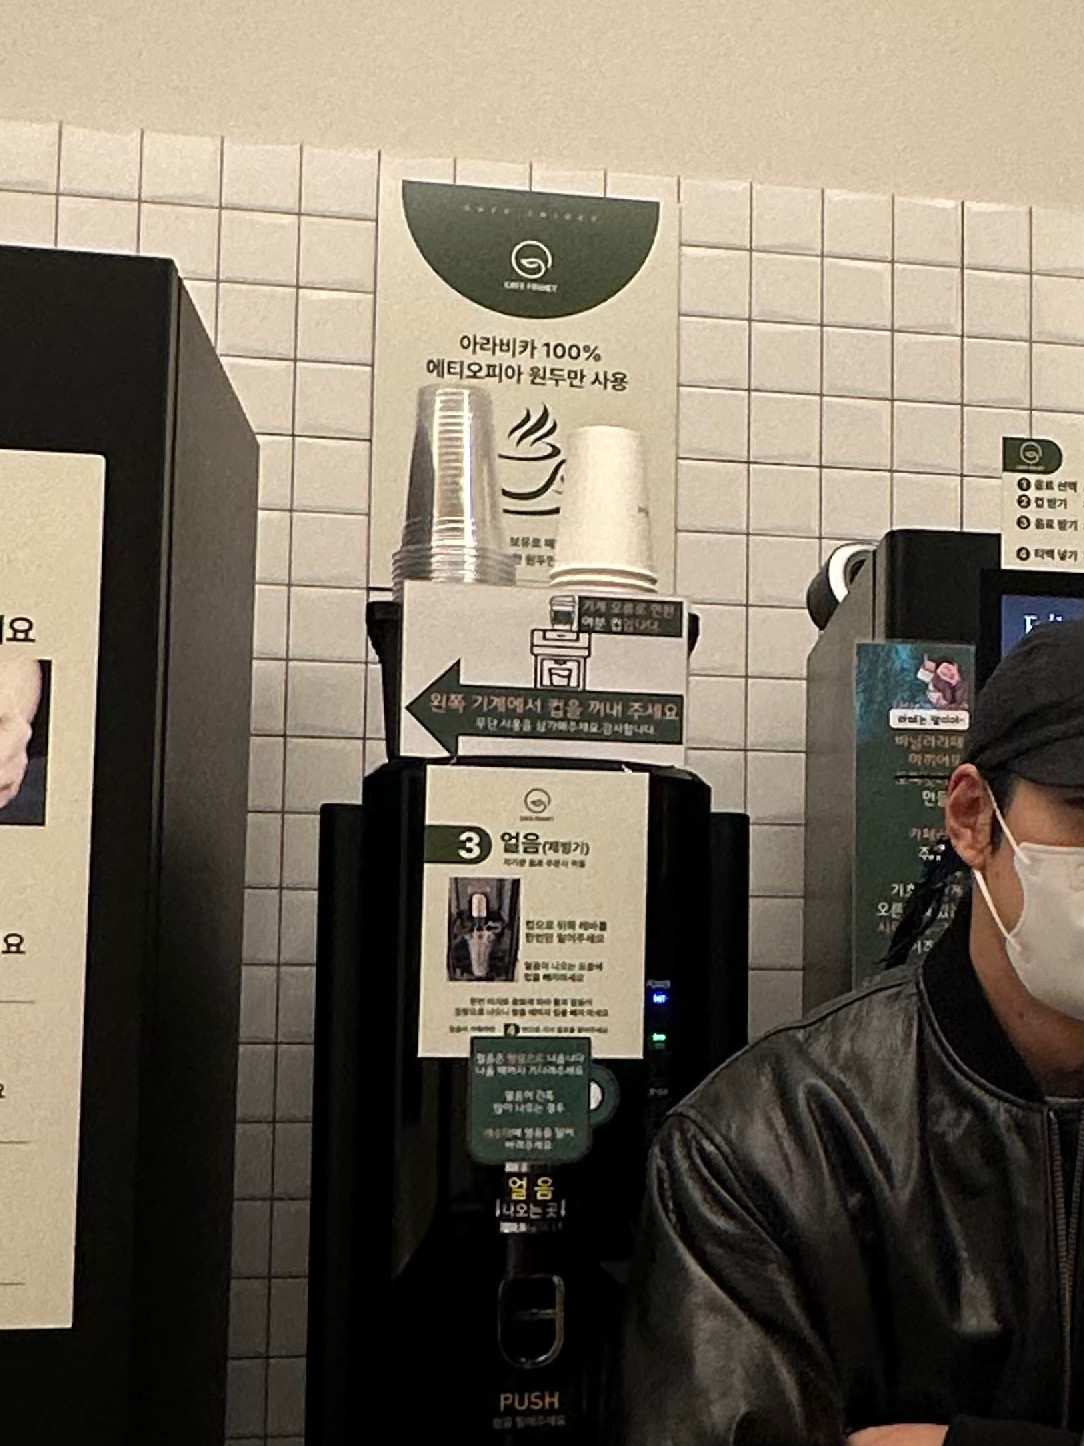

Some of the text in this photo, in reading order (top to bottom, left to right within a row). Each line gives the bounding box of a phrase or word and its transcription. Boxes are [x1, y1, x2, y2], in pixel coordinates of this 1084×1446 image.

[460, 334, 602, 362] 아라비카 100%
[426, 358, 629, 391] 에티오피아 원두만 사용
[0, 616, 36, 644] 요
[430, 693, 679, 721] 왼쪽 기계에서 컵을 꺼내 주세요
[457, 831, 481, 859] 3
[508, 1176, 555, 1200] 얼음
[499, 1391, 560, 1412] PUSH
